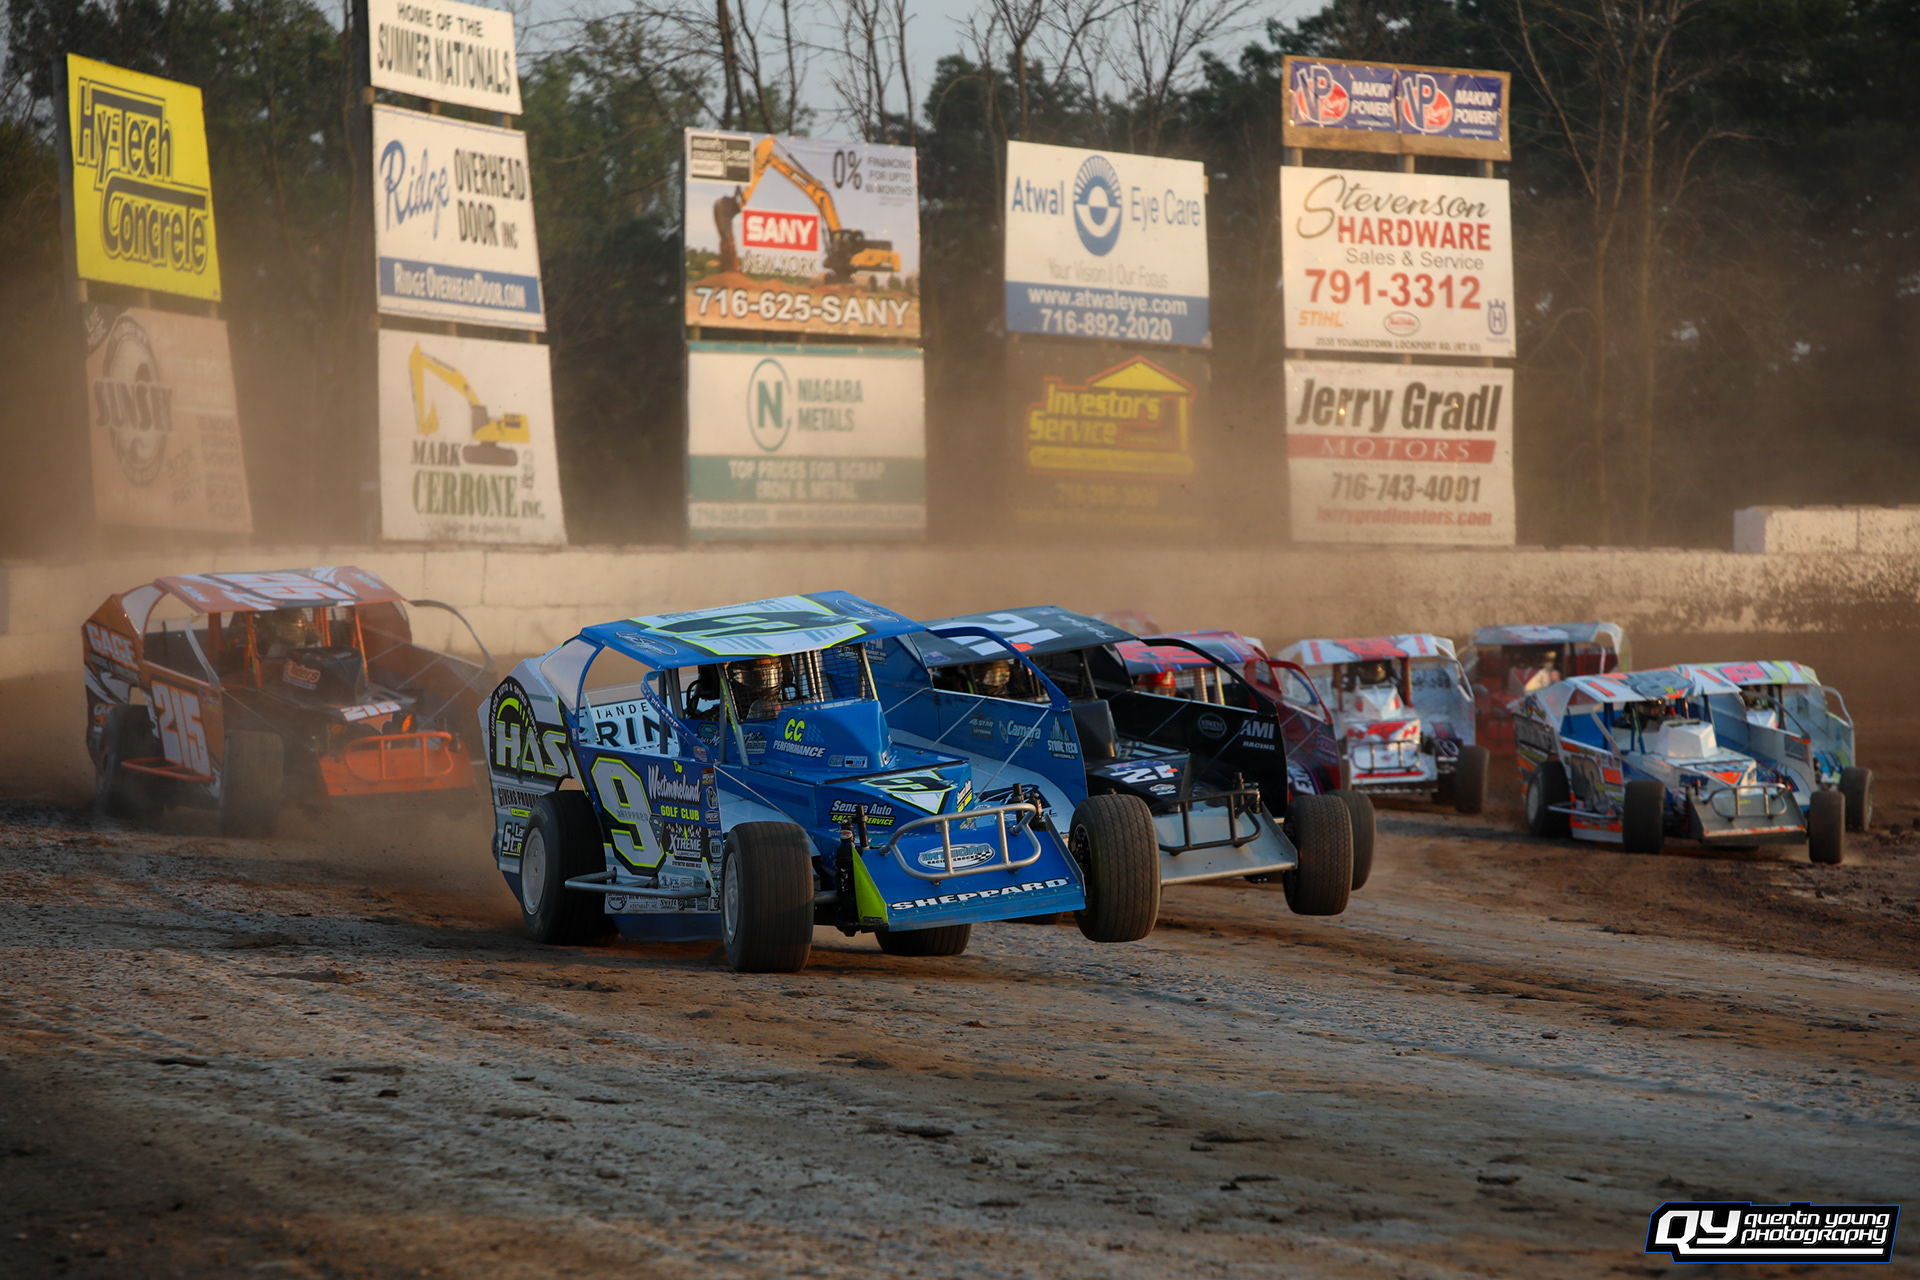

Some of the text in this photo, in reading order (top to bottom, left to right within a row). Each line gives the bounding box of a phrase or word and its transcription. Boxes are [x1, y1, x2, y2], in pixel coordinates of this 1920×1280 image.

[397, 3, 484, 38] HOME OF THE
[378, 22, 511, 95] SUMMER NATIONALS
[1454, 109, 1498, 126] POWER!
[454, 147, 526, 200] OVERHEAD
[833, 150, 863, 189] 0%
[869, 170, 887, 181] FOR
[380, 139, 449, 240] Ridge
[1011, 176, 1065, 217] Atwal
[1296, 173, 1489, 239] Stevenson
[102, 174, 208, 274] Concrete
[457, 200, 498, 247] DOOR
[1131, 186, 1200, 232] Eye Care
[747, 215, 814, 246] SANY
[1337, 215, 1492, 251] HARDWARE
[742, 252, 819, 279] NEW YORK
[1346, 247, 1484, 271] Sales & Service
[1139, 265, 1169, 289] Focus
[1305, 268, 1482, 310] 791-3312
[696, 286, 910, 327] 716-625-SANY
[1027, 287, 1188, 318] www.atwaleye.com
[1298, 310, 1345, 328] STIHL
[1040, 308, 1173, 341] 716-892-2020
[797, 378, 864, 404] NIAGARA
[1046, 383, 1162, 421] Investor's
[1295, 378, 1503, 434] Jerry Gradl
[797, 407, 856, 432] METALS
[1028, 410, 1118, 445] Service
[410, 439, 463, 467] MARK
[1320, 437, 1471, 461] MOTORS
[412, 469, 519, 519] CERRONE
[1331, 471, 1482, 503] 716-743-4001
[1240, 719, 1274, 740] AMI
[1242, 740, 1276, 751] RACING
[496, 719, 568, 778] HAS
[773, 739, 826, 758] PERFORMANCE
[592, 756, 665, 868] 9
[660, 804, 700, 822] GOLF CLUB
[832, 800, 893, 816] Senea Auto
[669, 833, 702, 852] XTREME
[890, 877, 1071, 911] SHEPPARD
